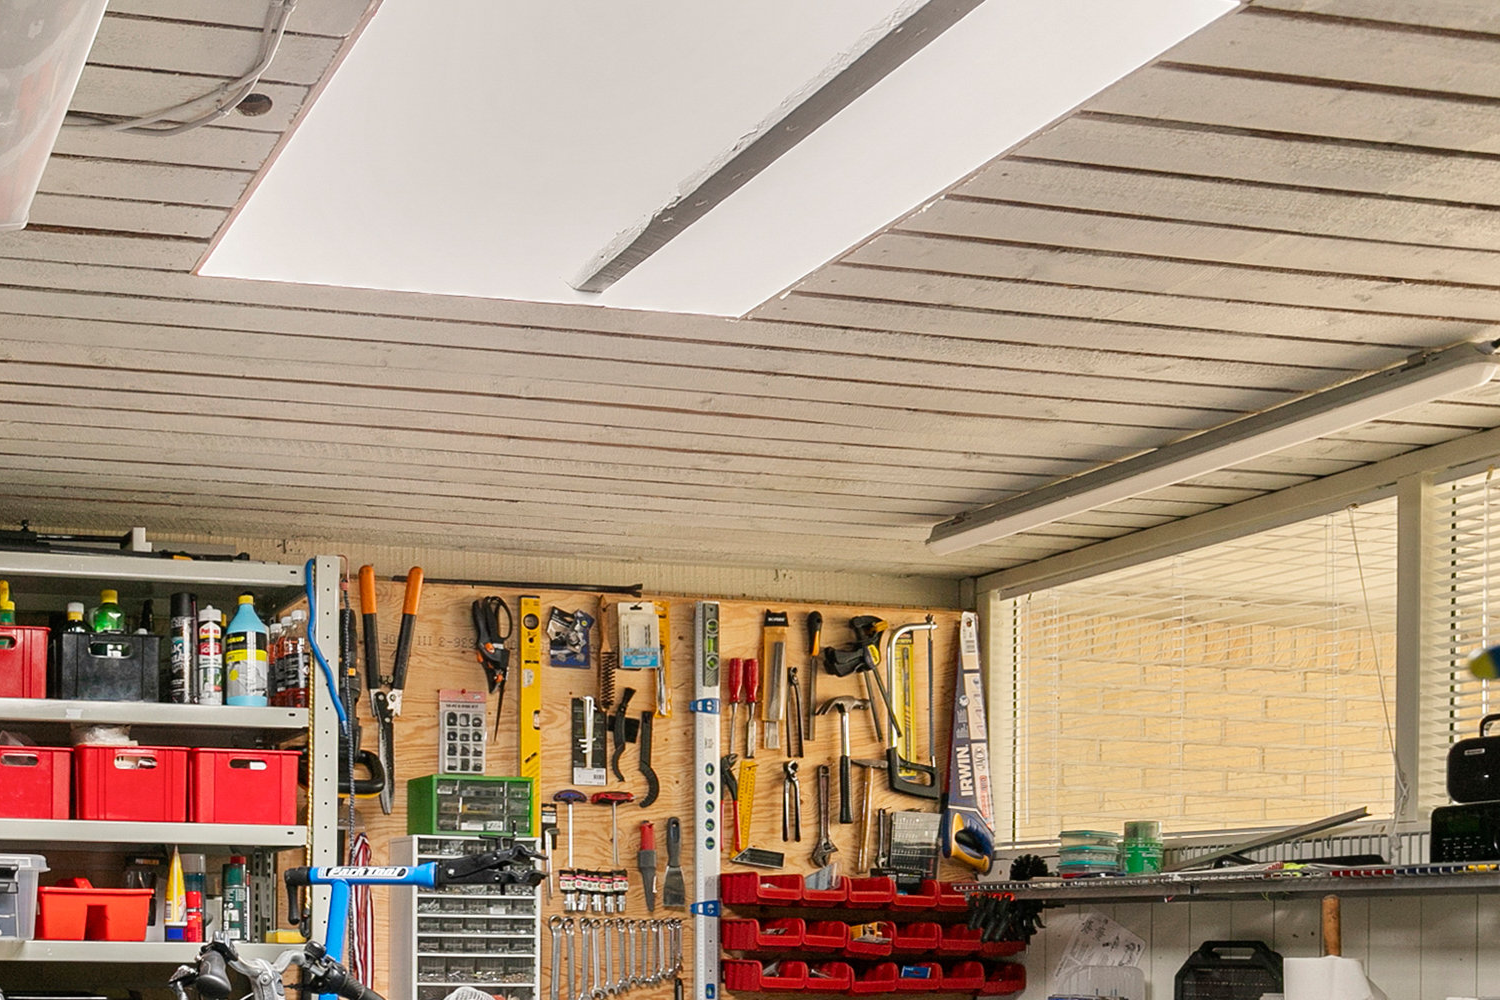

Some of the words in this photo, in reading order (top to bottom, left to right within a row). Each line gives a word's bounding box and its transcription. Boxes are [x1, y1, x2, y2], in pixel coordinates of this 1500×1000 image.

[956, 748, 974, 797] IRWIN
[328, 867, 365, 877] Park
[364, 867, 400, 877] Tool
